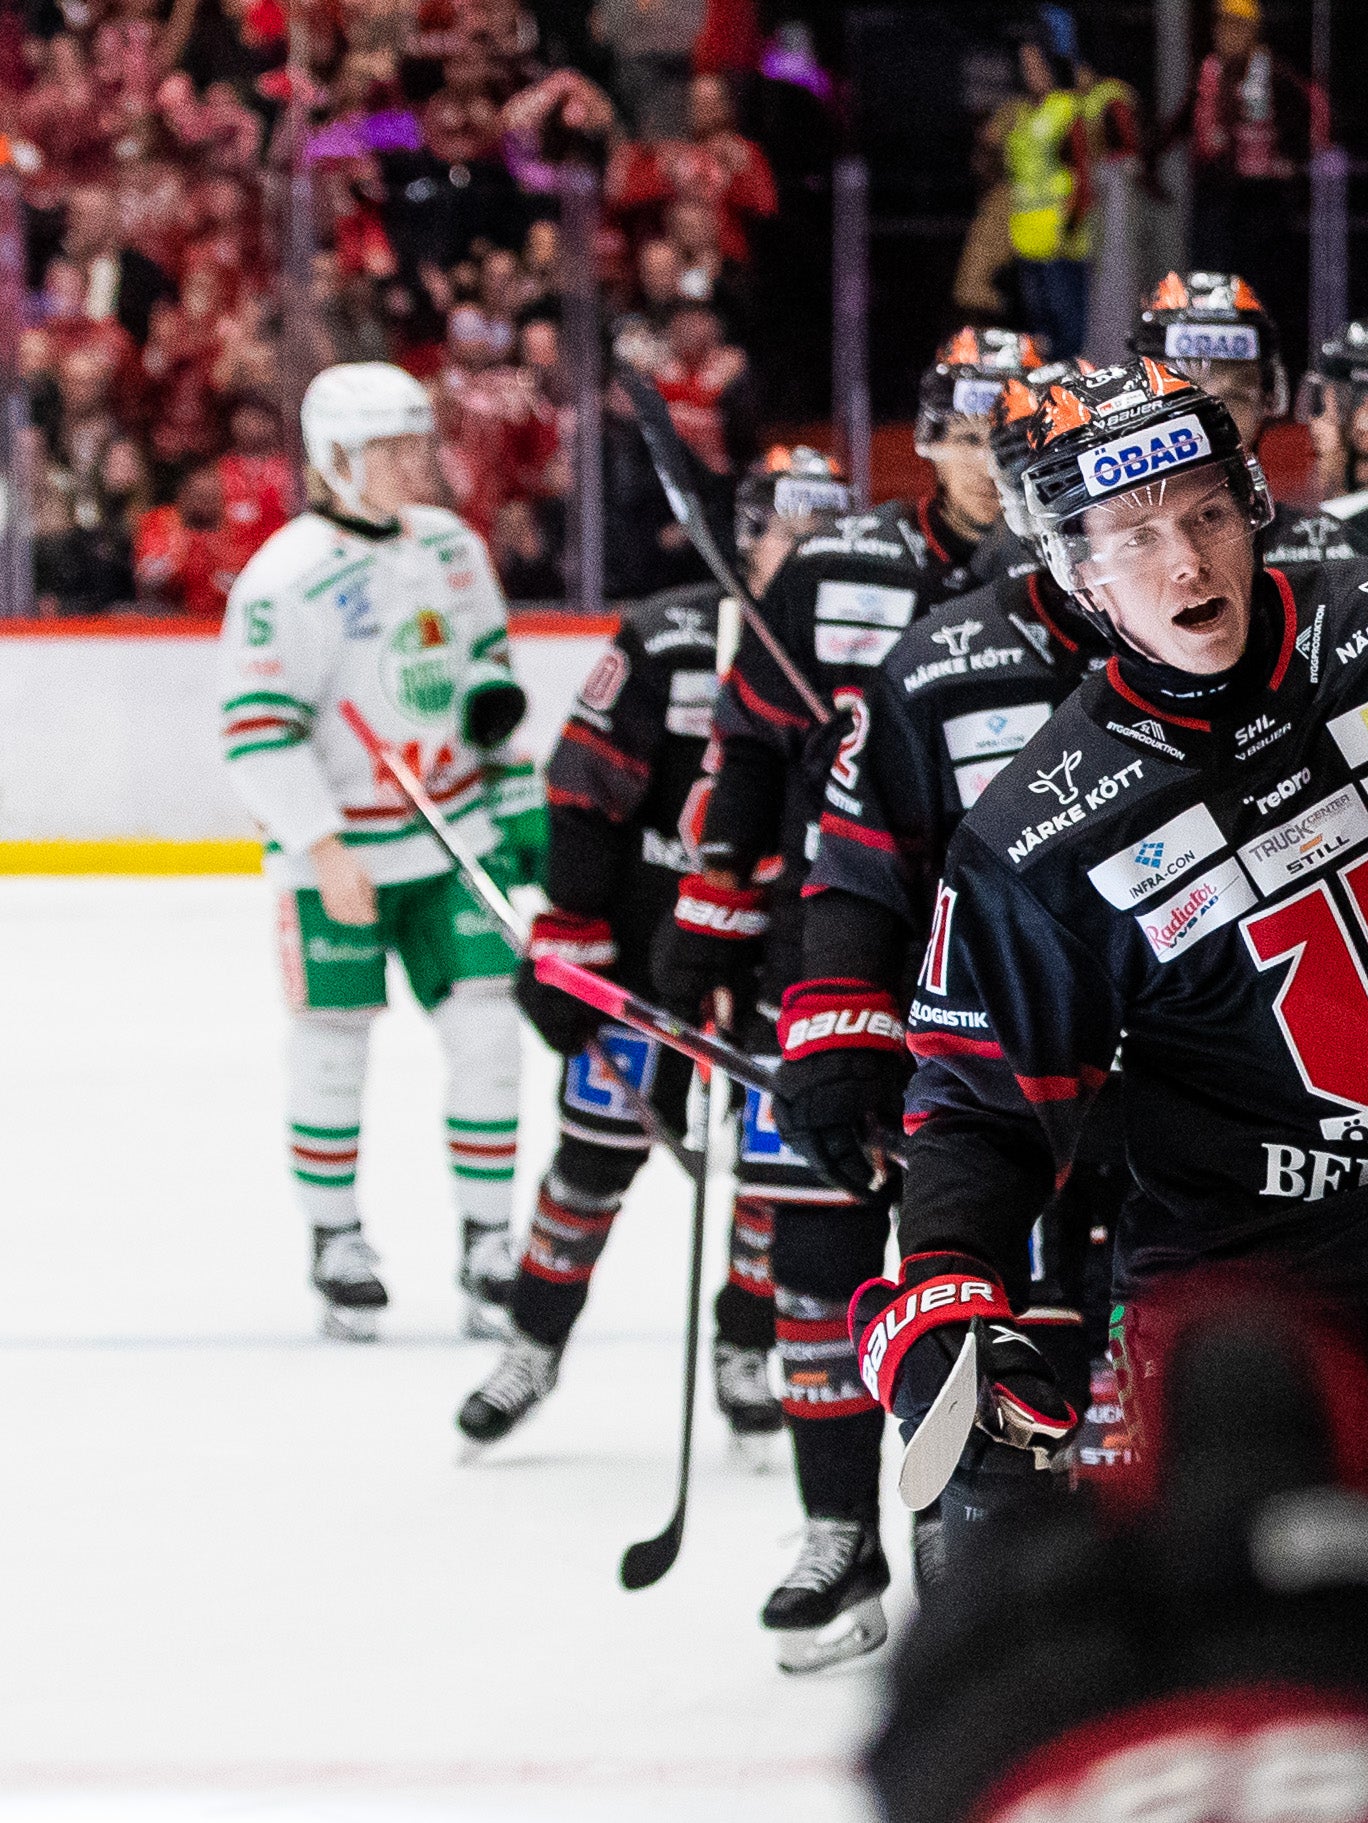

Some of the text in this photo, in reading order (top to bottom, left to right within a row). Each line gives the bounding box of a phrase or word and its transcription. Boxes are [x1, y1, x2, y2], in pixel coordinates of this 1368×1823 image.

[1106, 400, 1164, 427] BAUER
[1093, 428, 1199, 487] ÖBAB
[1310, 604, 1327, 684] BYGGPRODUKTION
[1106, 721, 1186, 761] BYGGPRODUKTION
[1234, 714, 1276, 747] SHL
[1247, 722, 1292, 757] BAUER
[1007, 759, 1145, 864] NÄRKE KÖTT
[1243, 767, 1311, 816] rebro
[1129, 850, 1196, 900] INFRA-CON
[1286, 835, 1351, 875] STILL
[1146, 882, 1218, 951] Radiator
[862, 1281, 995, 1402] BAUER
